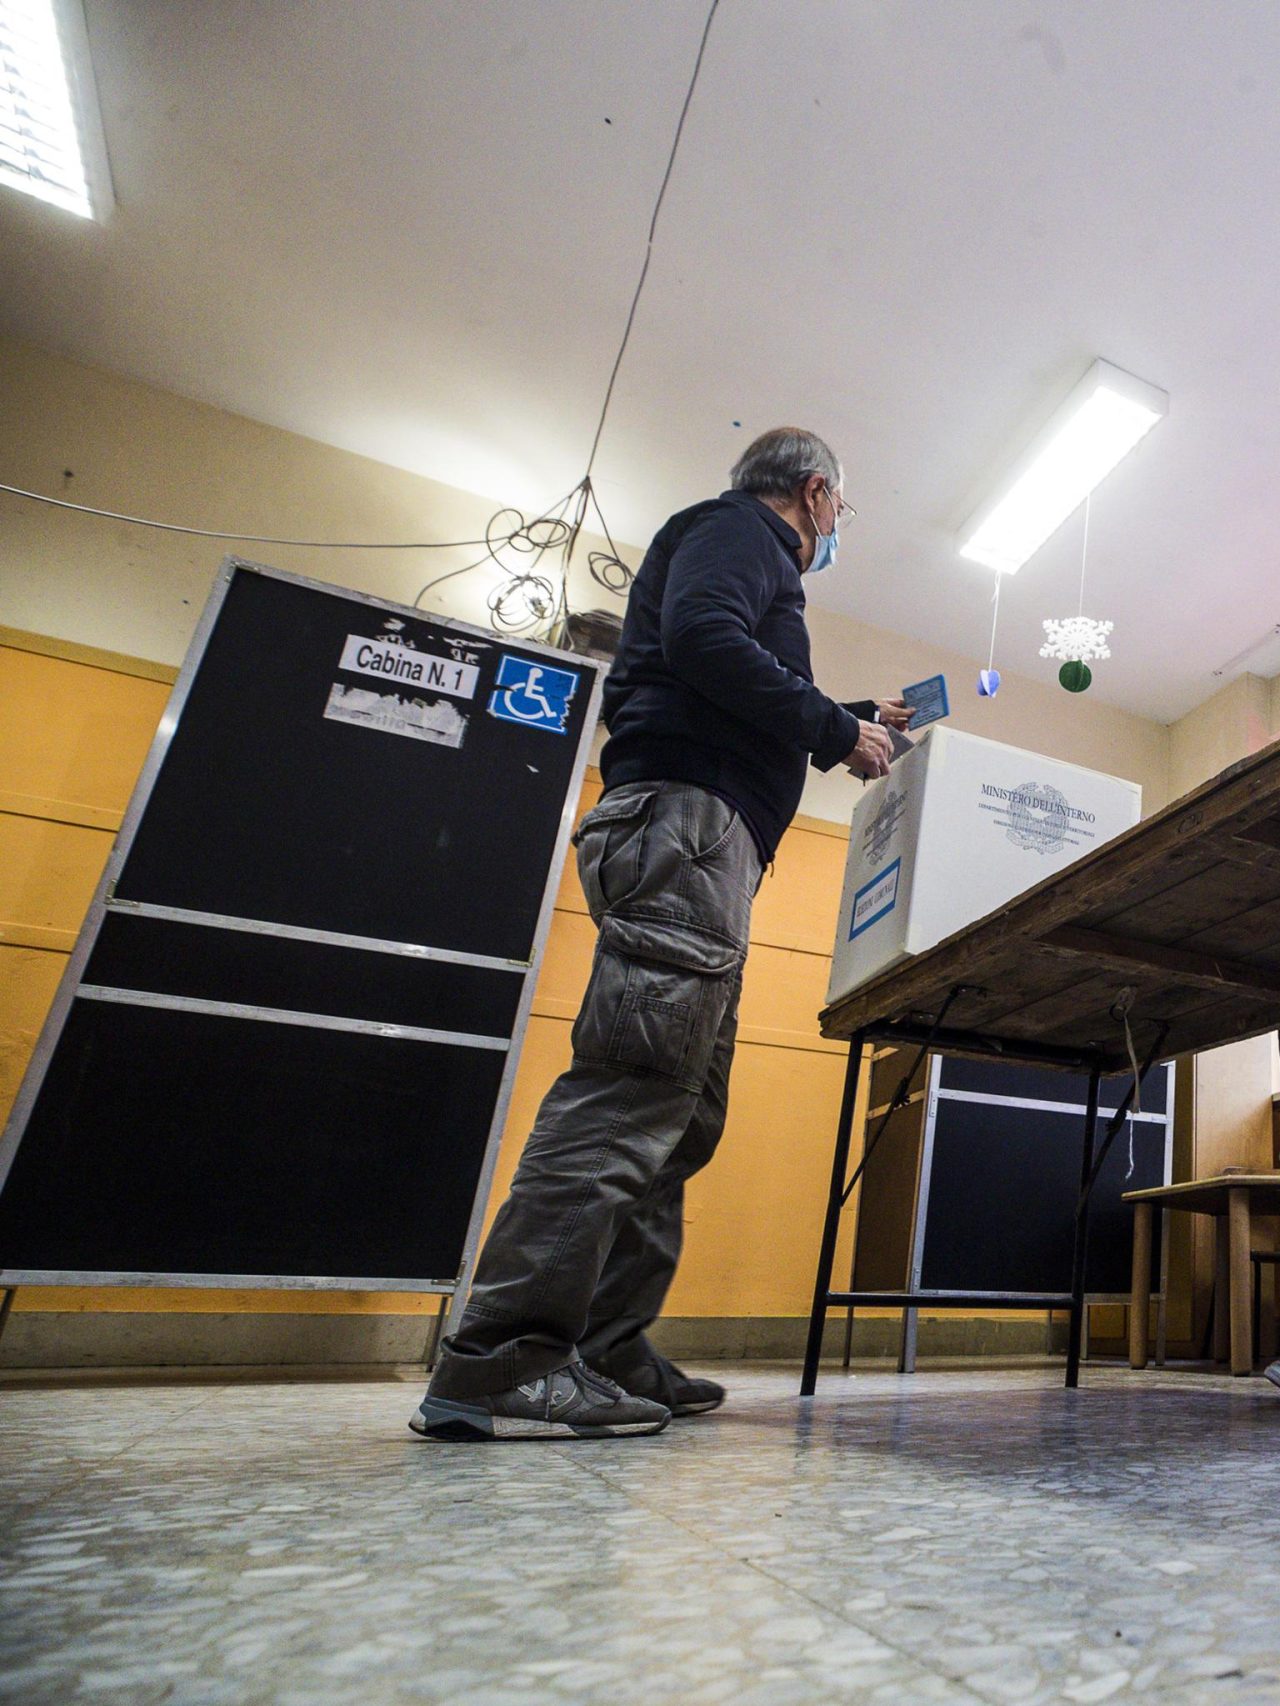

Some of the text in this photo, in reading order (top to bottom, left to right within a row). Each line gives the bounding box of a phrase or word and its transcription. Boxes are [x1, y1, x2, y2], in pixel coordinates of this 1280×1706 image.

[356, 644, 464, 690] Cabina N. 1
[981, 784, 1031, 806] MINISTERO
[1032, 799, 1096, 823] DELL'INTERNO
